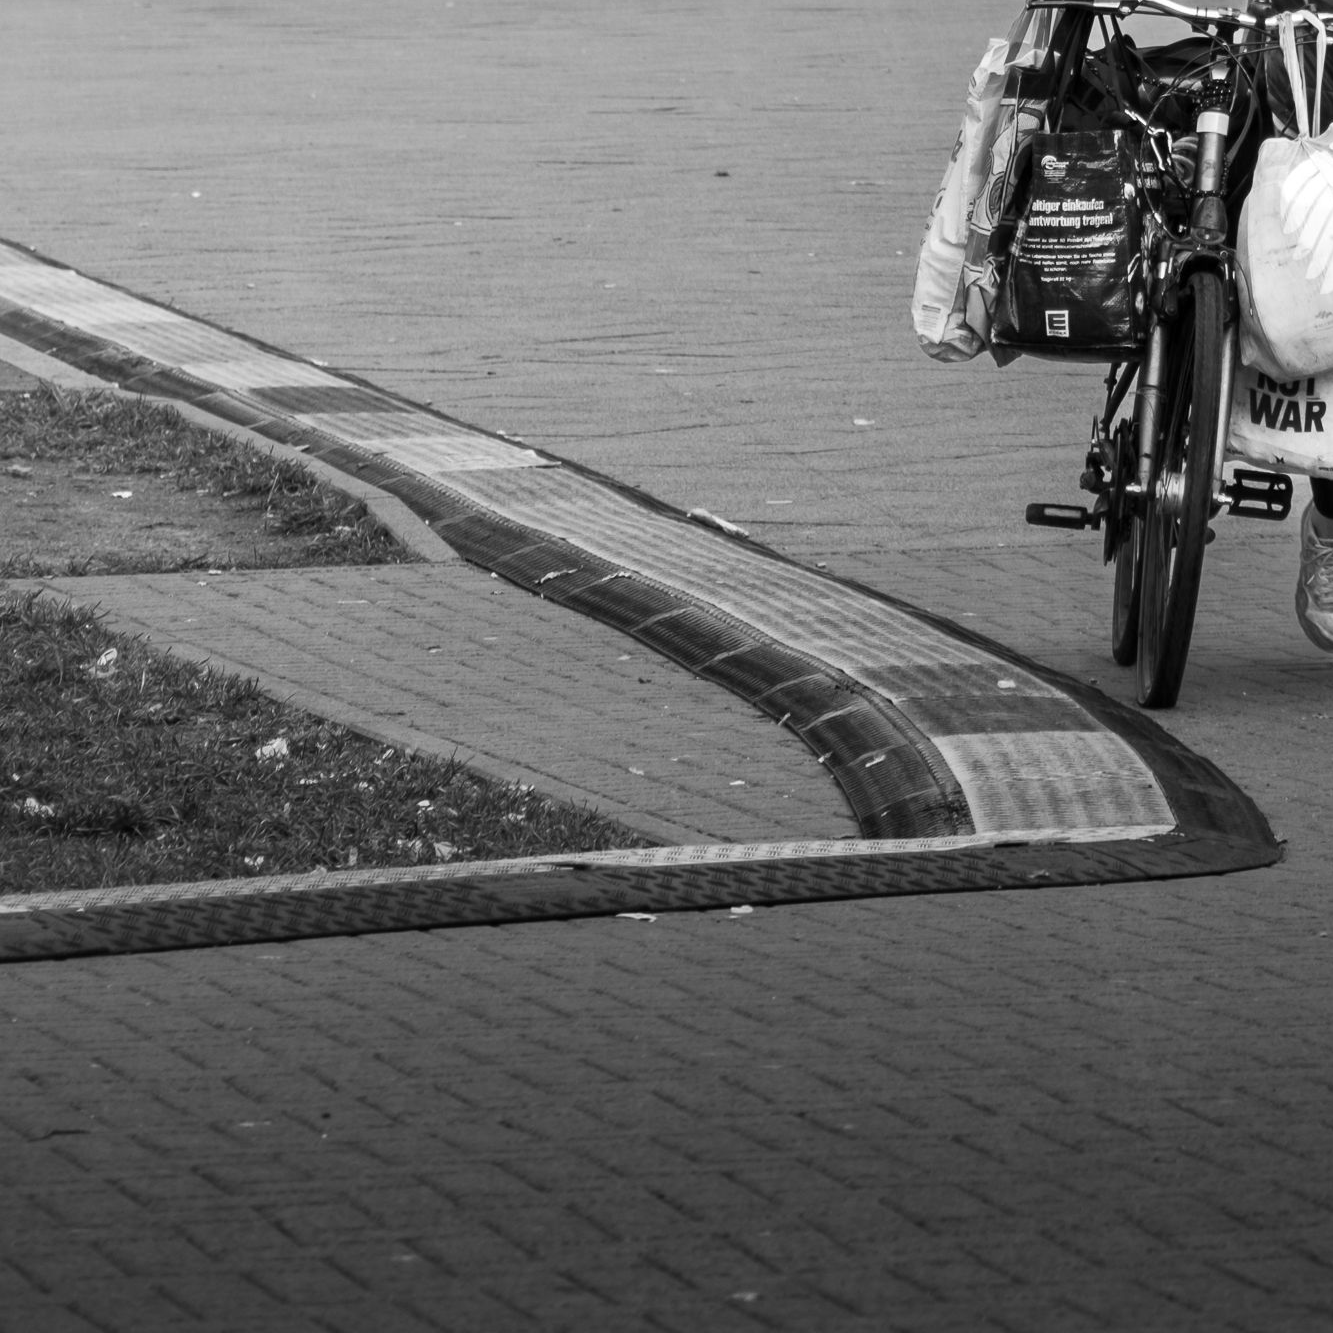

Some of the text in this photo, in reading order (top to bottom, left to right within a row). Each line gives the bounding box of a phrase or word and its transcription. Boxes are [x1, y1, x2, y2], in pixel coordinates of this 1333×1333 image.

[1031, 198, 1104, 214] altiger einkaufen
[1028, 212, 1113, 229] antwortung tragen!
[1249, 387, 1327, 433] WAR
